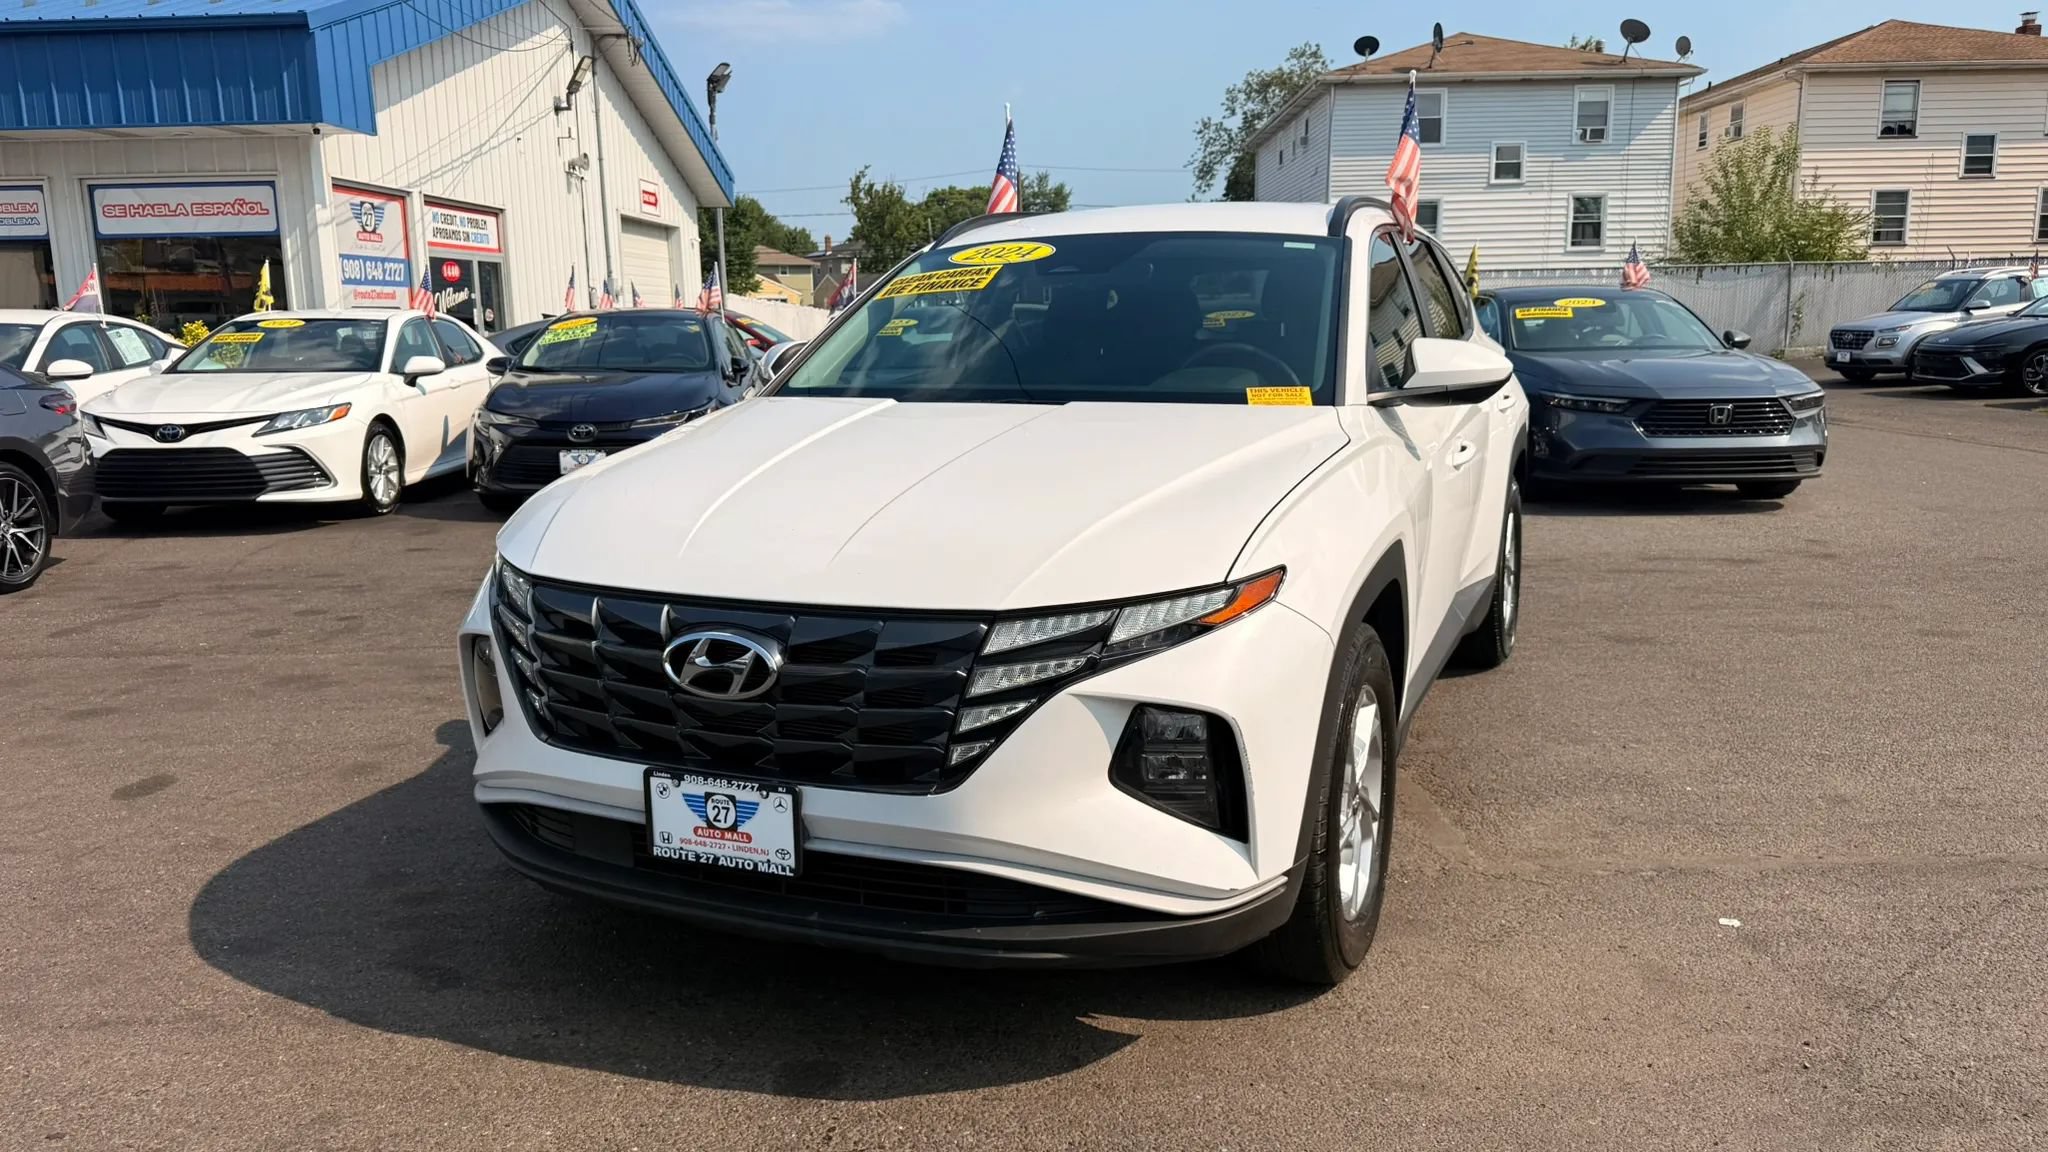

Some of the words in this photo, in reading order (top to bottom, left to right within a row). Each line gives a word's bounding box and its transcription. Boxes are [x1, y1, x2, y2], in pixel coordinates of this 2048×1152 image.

[102, 204, 127, 218] SE
[129, 203, 189, 217] HABLA
[191, 198, 270, 216] ESPAÑOL
[363, 212, 373, 227] 27
[432, 211, 439, 224] NO
[440, 212, 459, 228] CREDIT,
[459, 215, 466, 228] NO
[467, 217, 488, 231] PROBLEM
[432, 226, 461, 241] APROBAMOS
[462, 230, 470, 242] SIN
[963, 245, 1042, 261] 2024
[339, 257, 364, 282] (908)
[366, 260, 383, 280] 648
[384, 262, 404, 281] 2727
[890, 271, 936, 287] CLEAN
[936, 267, 993, 282] CARFAX
[882, 285, 909, 298] WE
[909, 277, 986, 293] FINANCE
[434, 287, 469, 314] Welcome
[683, 774, 760, 793] 908-648-2727
[710, 798, 731, 806] ROUTE
[711, 805, 731, 824] 27
[679, 837, 727, 850] 908-648-2727
[697, 828, 721, 839] AUTO
[724, 831, 749, 843] MALL
[652, 845, 697, 862] ROUTE
[699, 851, 715, 865] 27
[718, 855, 754, 871] AUTO
[757, 862, 794, 877] MALL
